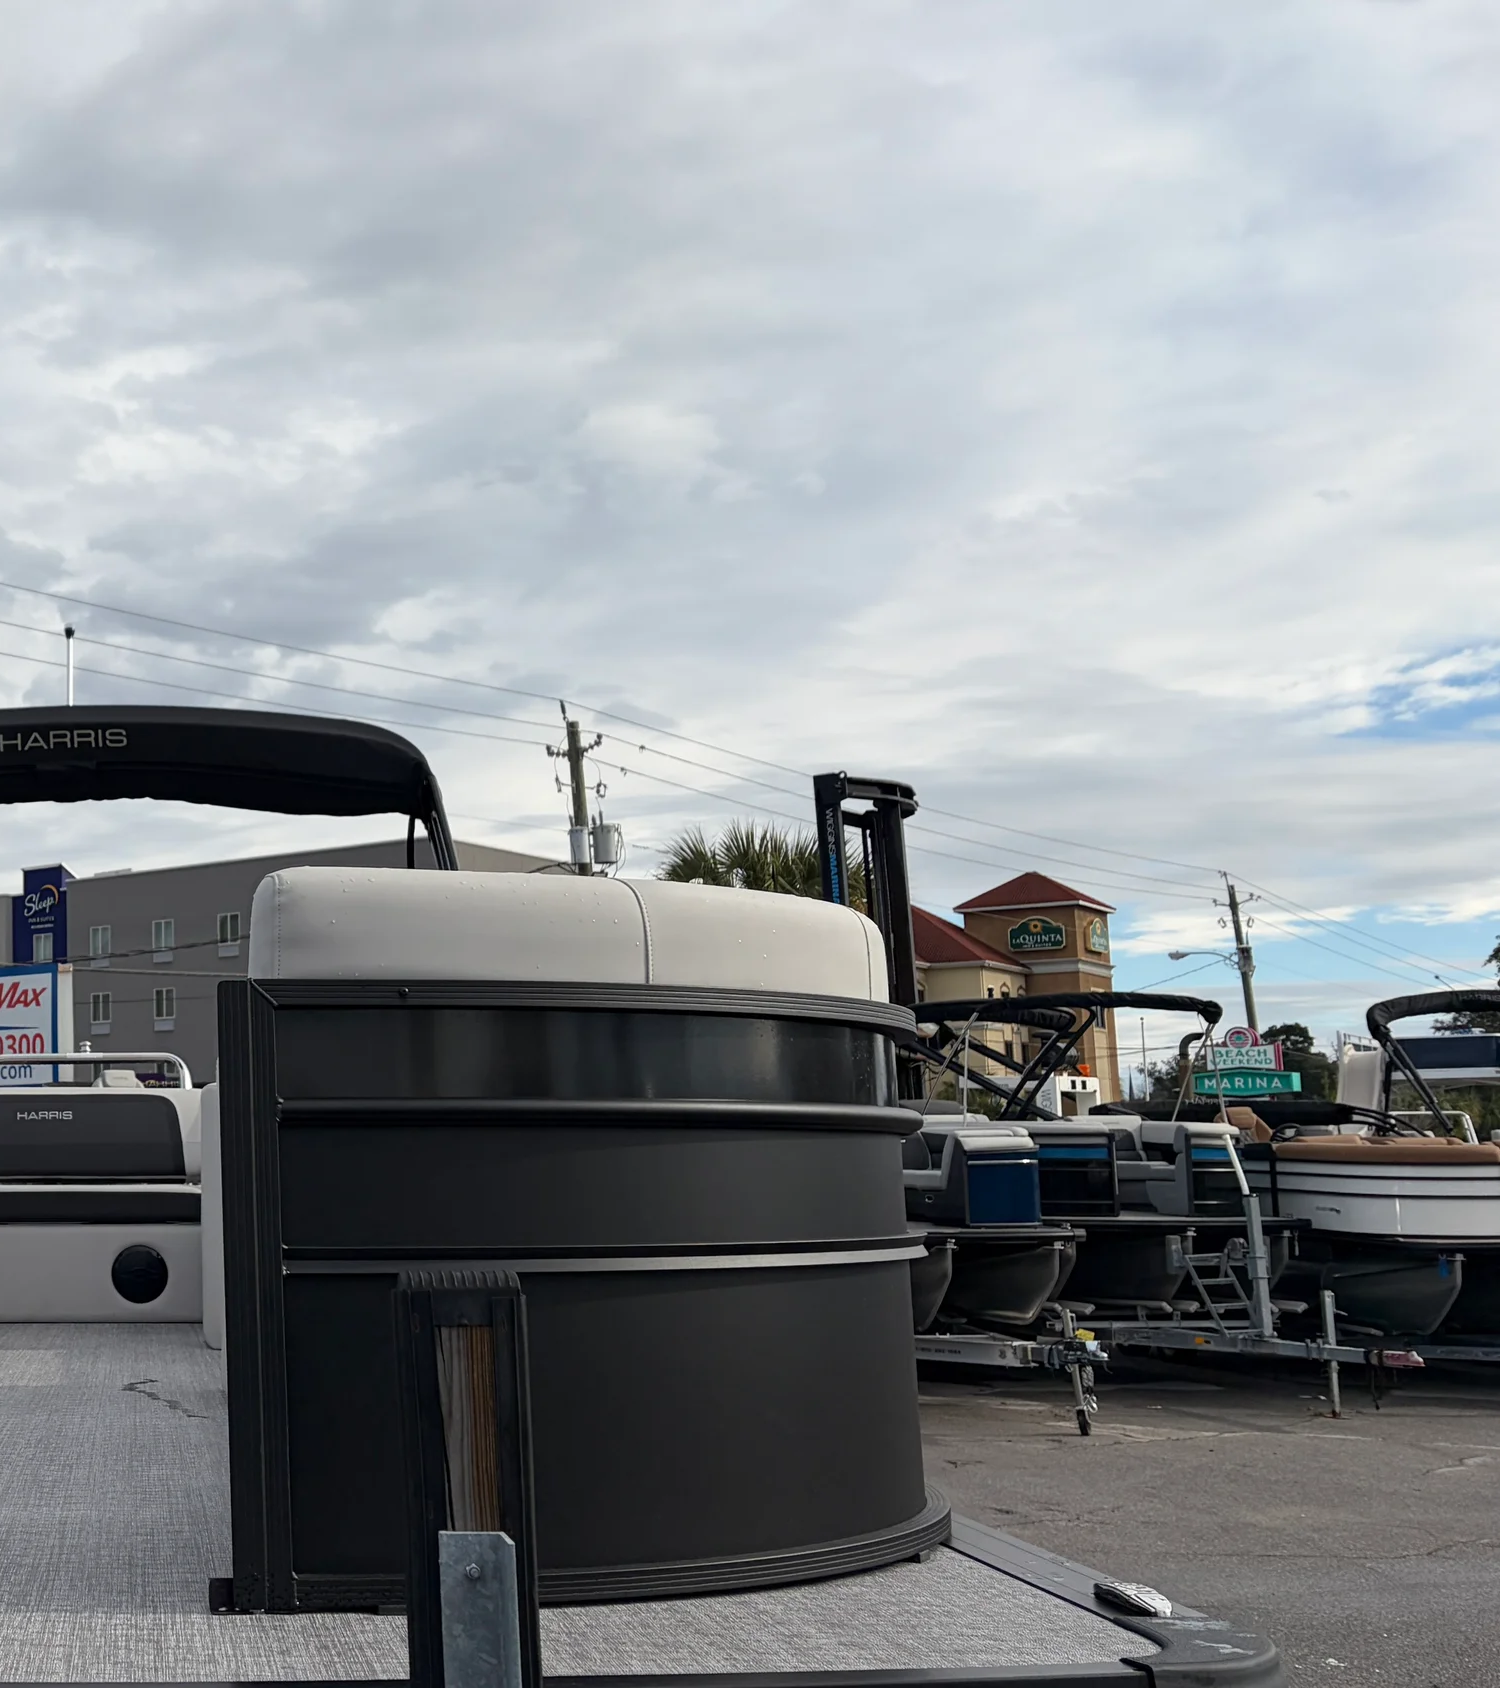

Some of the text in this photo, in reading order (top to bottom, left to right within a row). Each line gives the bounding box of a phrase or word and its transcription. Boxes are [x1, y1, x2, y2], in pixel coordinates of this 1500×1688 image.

[0, 729, 128, 752] HARRIS
[24, 892, 55, 917] Sleep
[1020, 934, 1062, 944] QUINTA
[1215, 1048, 1268, 1059] BEACH
[1210, 1057, 1273, 1066] WEEKEND
[1204, 1076, 1283, 1089] MARINA
[16, 1110, 73, 1120] HARRIS
